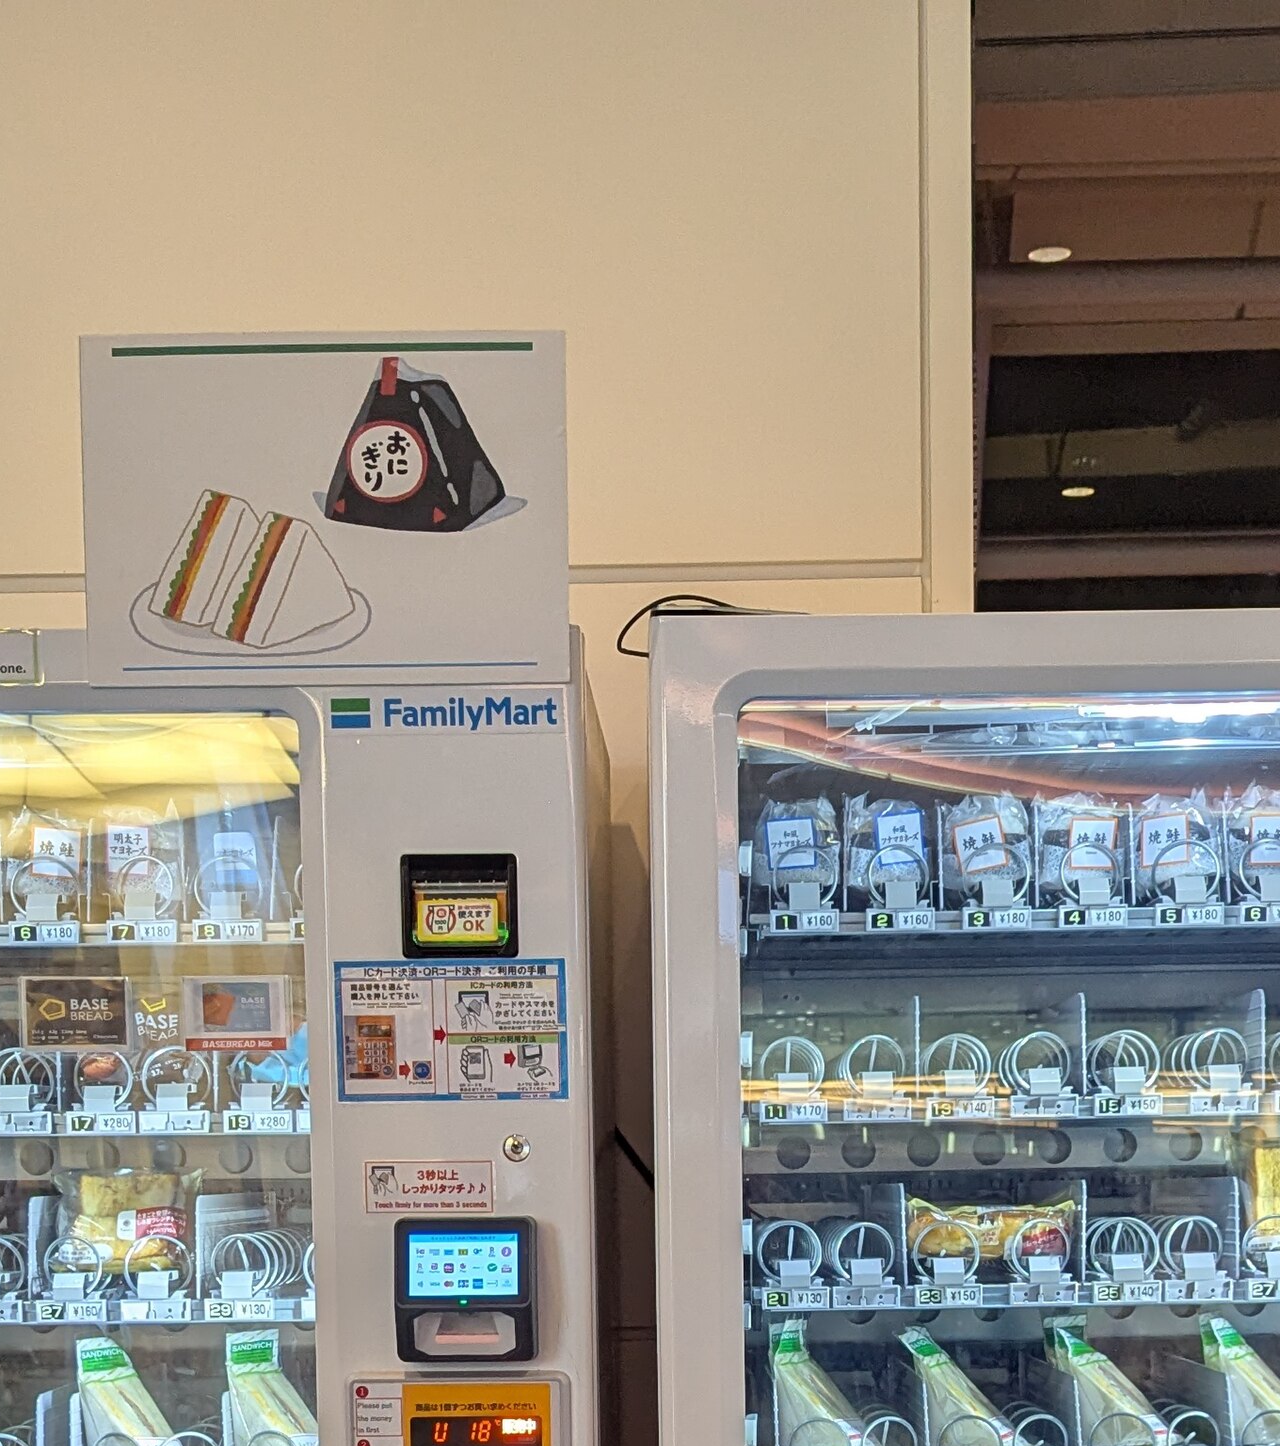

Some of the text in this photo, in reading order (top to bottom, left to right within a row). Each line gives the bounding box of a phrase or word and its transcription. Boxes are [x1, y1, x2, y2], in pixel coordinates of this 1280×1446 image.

[0, 664, 26, 675] one.
[384, 696, 558, 731] FamilyMart
[113, 832, 143, 844] 明太子
[962, 832, 995, 851] 焼鮭
[1148, 828, 1181, 845] 焼鮭
[39, 841, 74, 858] 焼鮭
[109, 845, 148, 856] マヨネーズ
[458, 910, 491, 918] 使えます
[1250, 908, 1261, 921] 6
[463, 920, 485, 931] OK
[782, 915, 832, 927] 1 ¥160
[204, 925, 254, 938] 8 ¥170
[71, 999, 109, 1011] BASE
[240, 996, 265, 1004] BASE
[70, 1011, 113, 1021] BREAD
[495, 1010, 555, 1018] かざしてください
[135, 1012, 178, 1030] BASE
[202, 1039, 273, 1048] BASEBREAD MIX
[72, 1117, 129, 1129] 17 ¥280
[417, 1169, 459, 1181] 3秒以上
[395, 1201, 411, 1209] firmly
[920, 1290, 976, 1303] 23 ¥150
[41, 1305, 97, 1319] 27 ¥160
[232, 1340, 272, 1353] SANDWICH
[81, 1347, 123, 1360] SANDWICH
